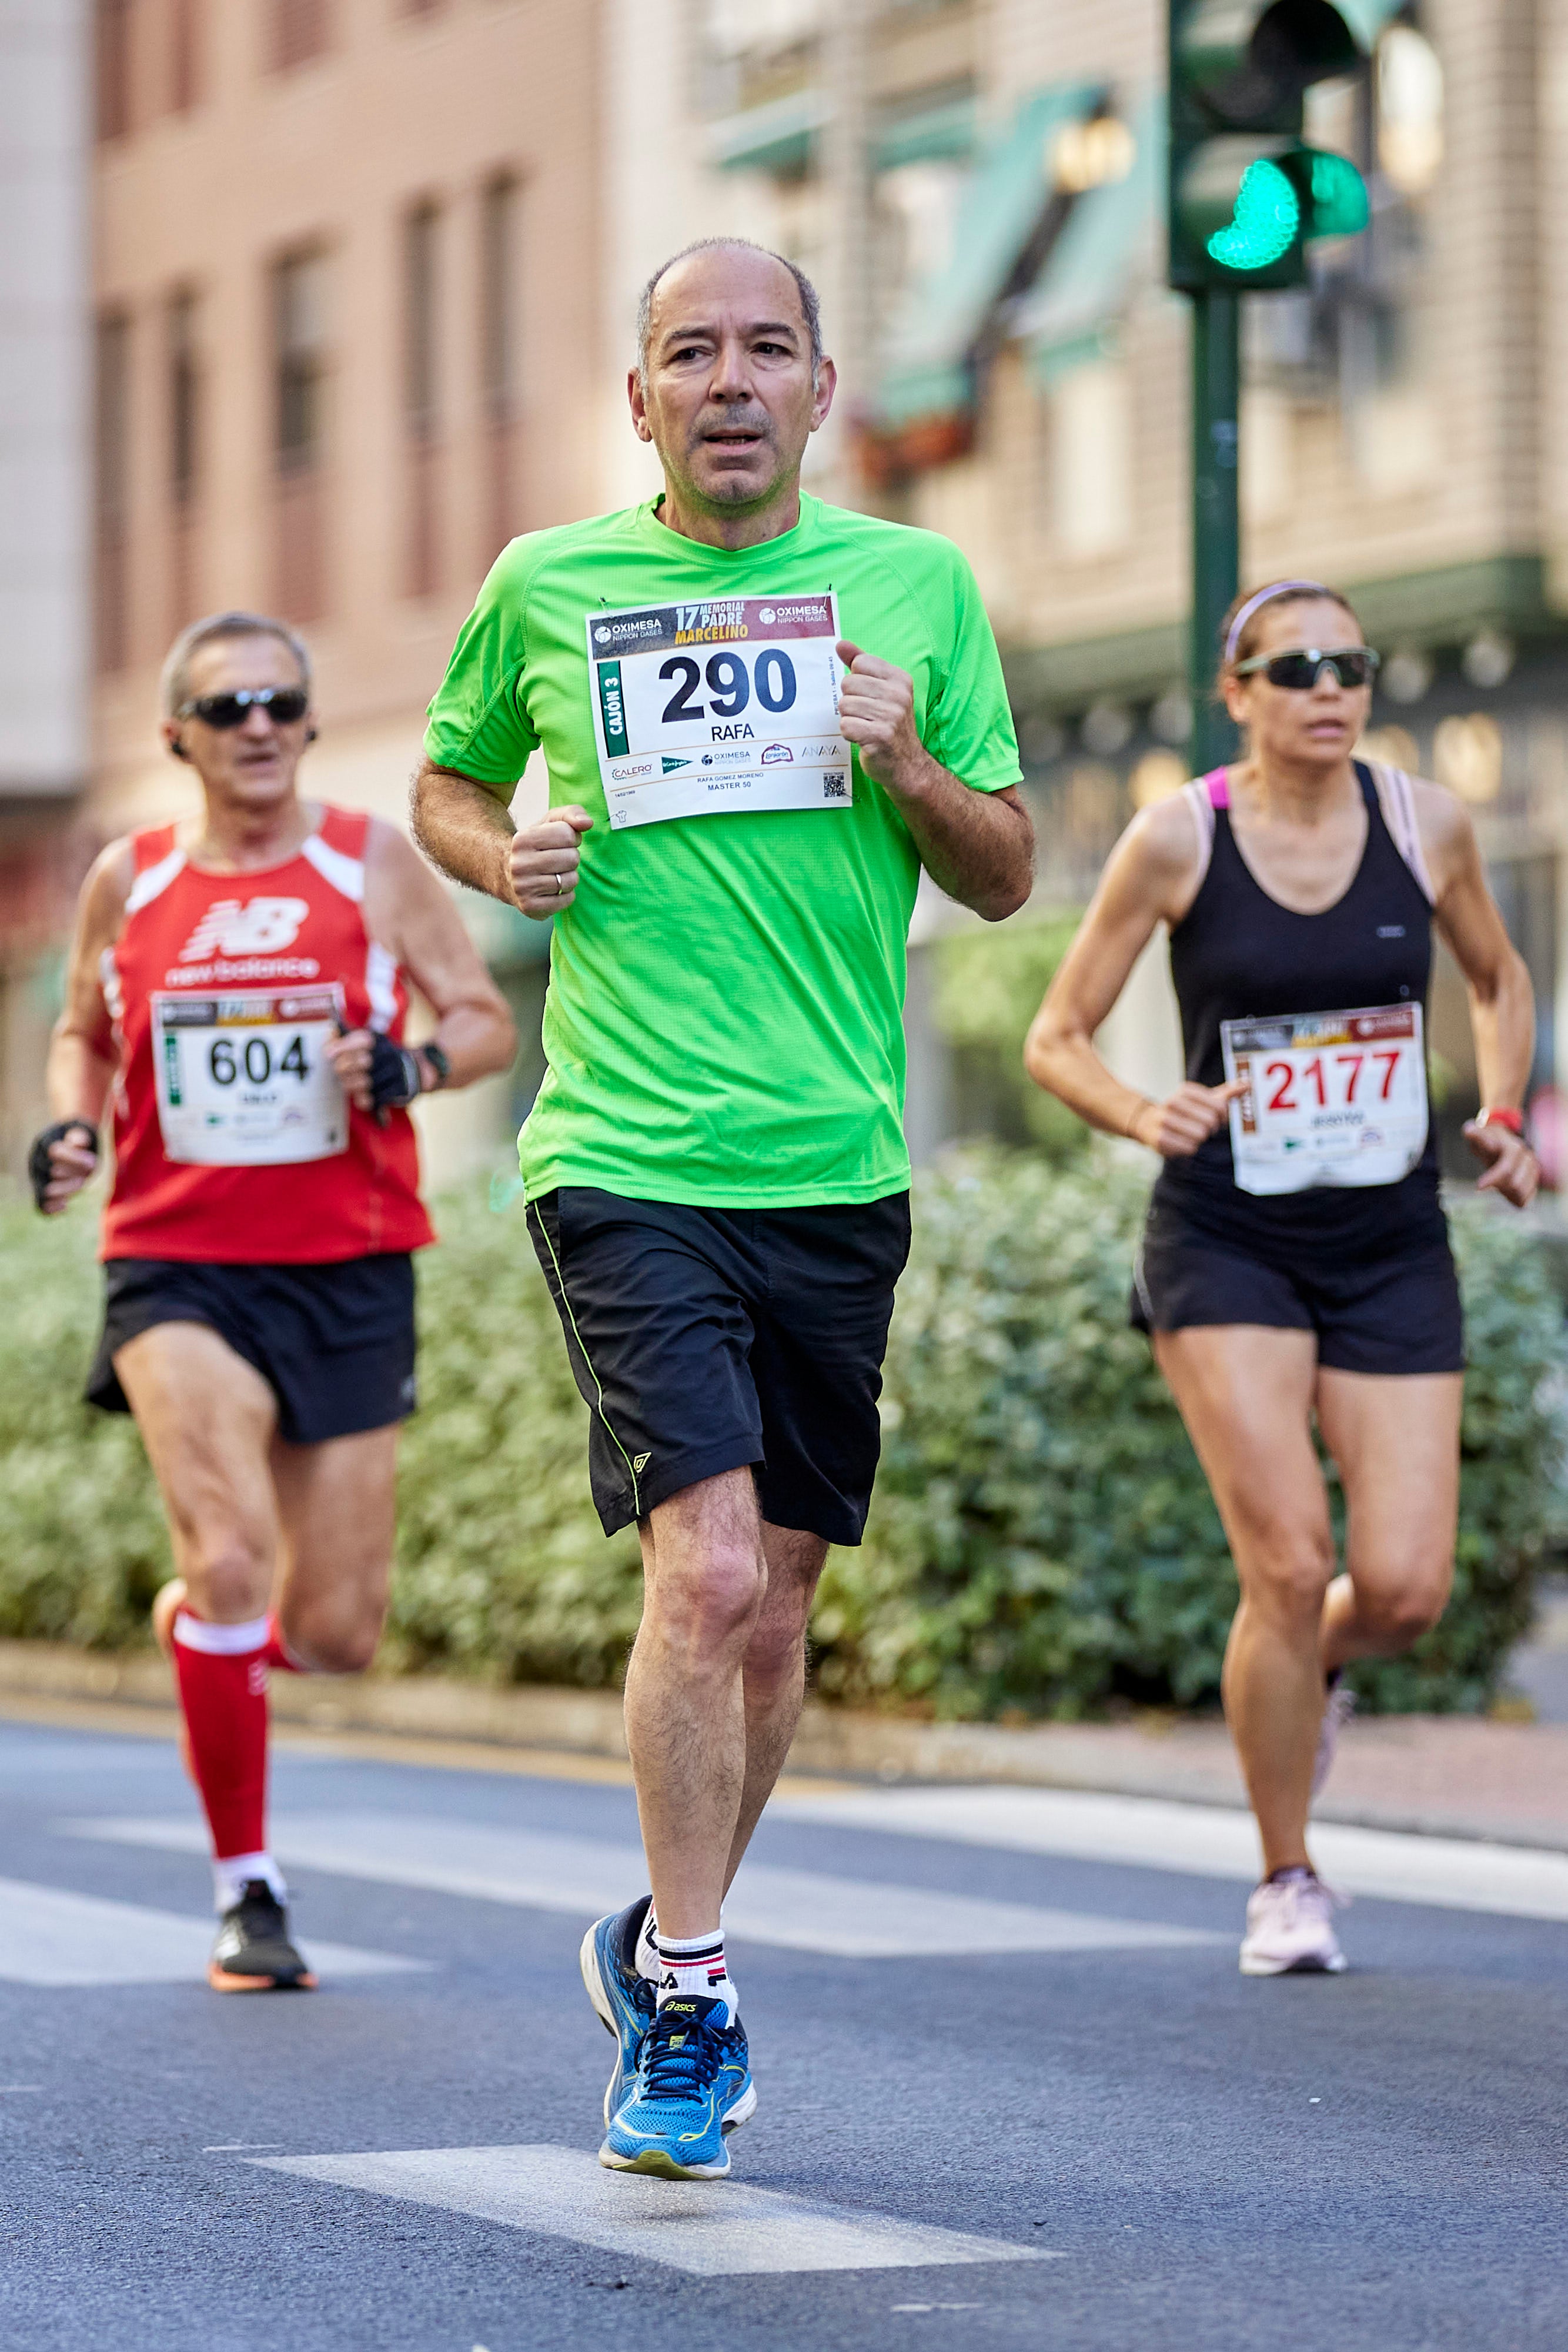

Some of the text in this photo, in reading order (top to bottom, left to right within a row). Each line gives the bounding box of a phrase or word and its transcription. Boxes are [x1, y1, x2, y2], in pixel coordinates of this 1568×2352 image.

[700, 602, 745, 615] MEMORIAL
[777, 606, 827, 616] OXIMESA
[612, 619, 662, 634] OXIMESA
[676, 606, 700, 631] 17
[701, 612, 743, 629] PADRE
[612, 629, 663, 641] NIPPON GASES
[674, 624, 748, 645] MARCELINO
[658, 649, 797, 723] 290
[604, 677, 623, 735] CAJÓN 3
[711, 723, 755, 741] RAFA
[714, 751, 751, 760] OXIMESA
[615, 764, 651, 777] CALERO
[708, 782, 741, 791] MASTER
[165, 958, 320, 988] new balance
[210, 1035, 310, 1085] 604
[1265, 1051, 1402, 1112] 2177
[673, 2003, 697, 2012] asics
